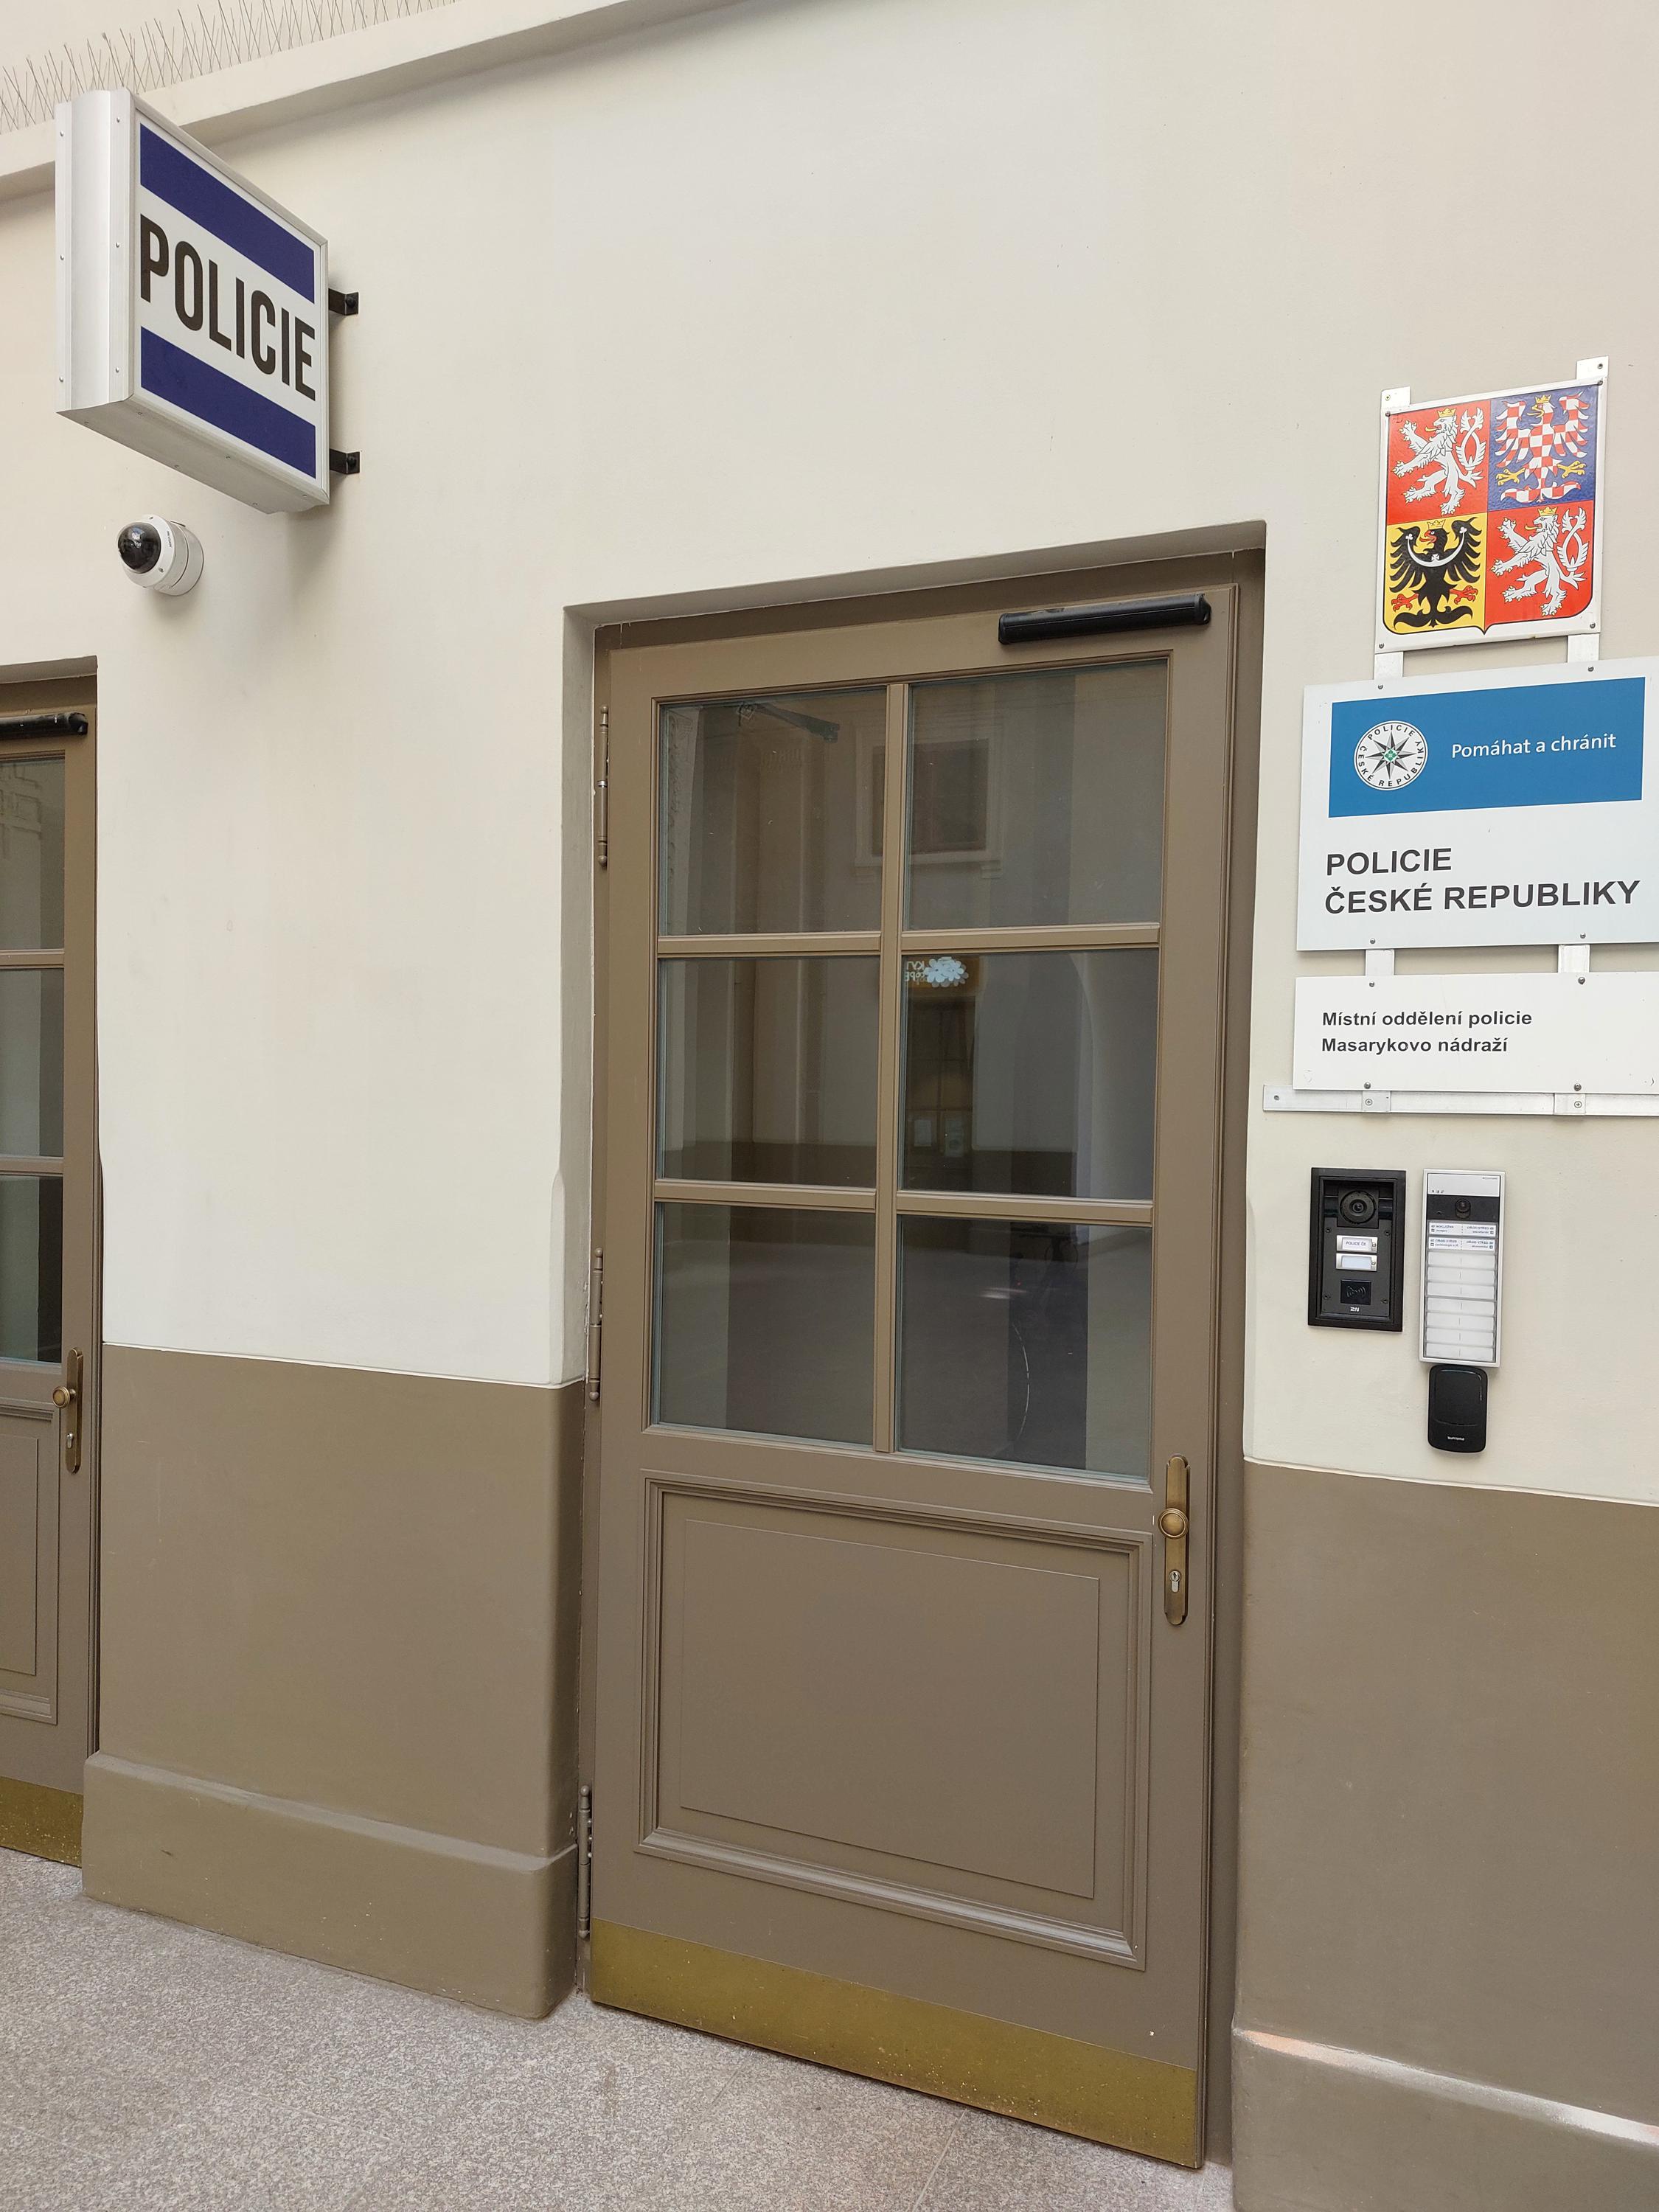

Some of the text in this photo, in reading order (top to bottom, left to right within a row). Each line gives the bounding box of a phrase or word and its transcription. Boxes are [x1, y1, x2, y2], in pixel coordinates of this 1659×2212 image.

[140, 212, 316, 402] POLICIE
[1367, 724, 1416, 740] POLICIE
[1451, 733, 1617, 759] Pomáhat a chránit
[1357, 740, 1425, 787] ČESKÉ REPUBLIKY
[1327, 847, 1452, 876] POLICIE
[1325, 880, 1641, 914] ČESKÉ REPUBLIKY
[1322, 1011, 1533, 1029] Místní oddělení policie
[1321, 1037, 1508, 1055] Masarykovo nádraží
